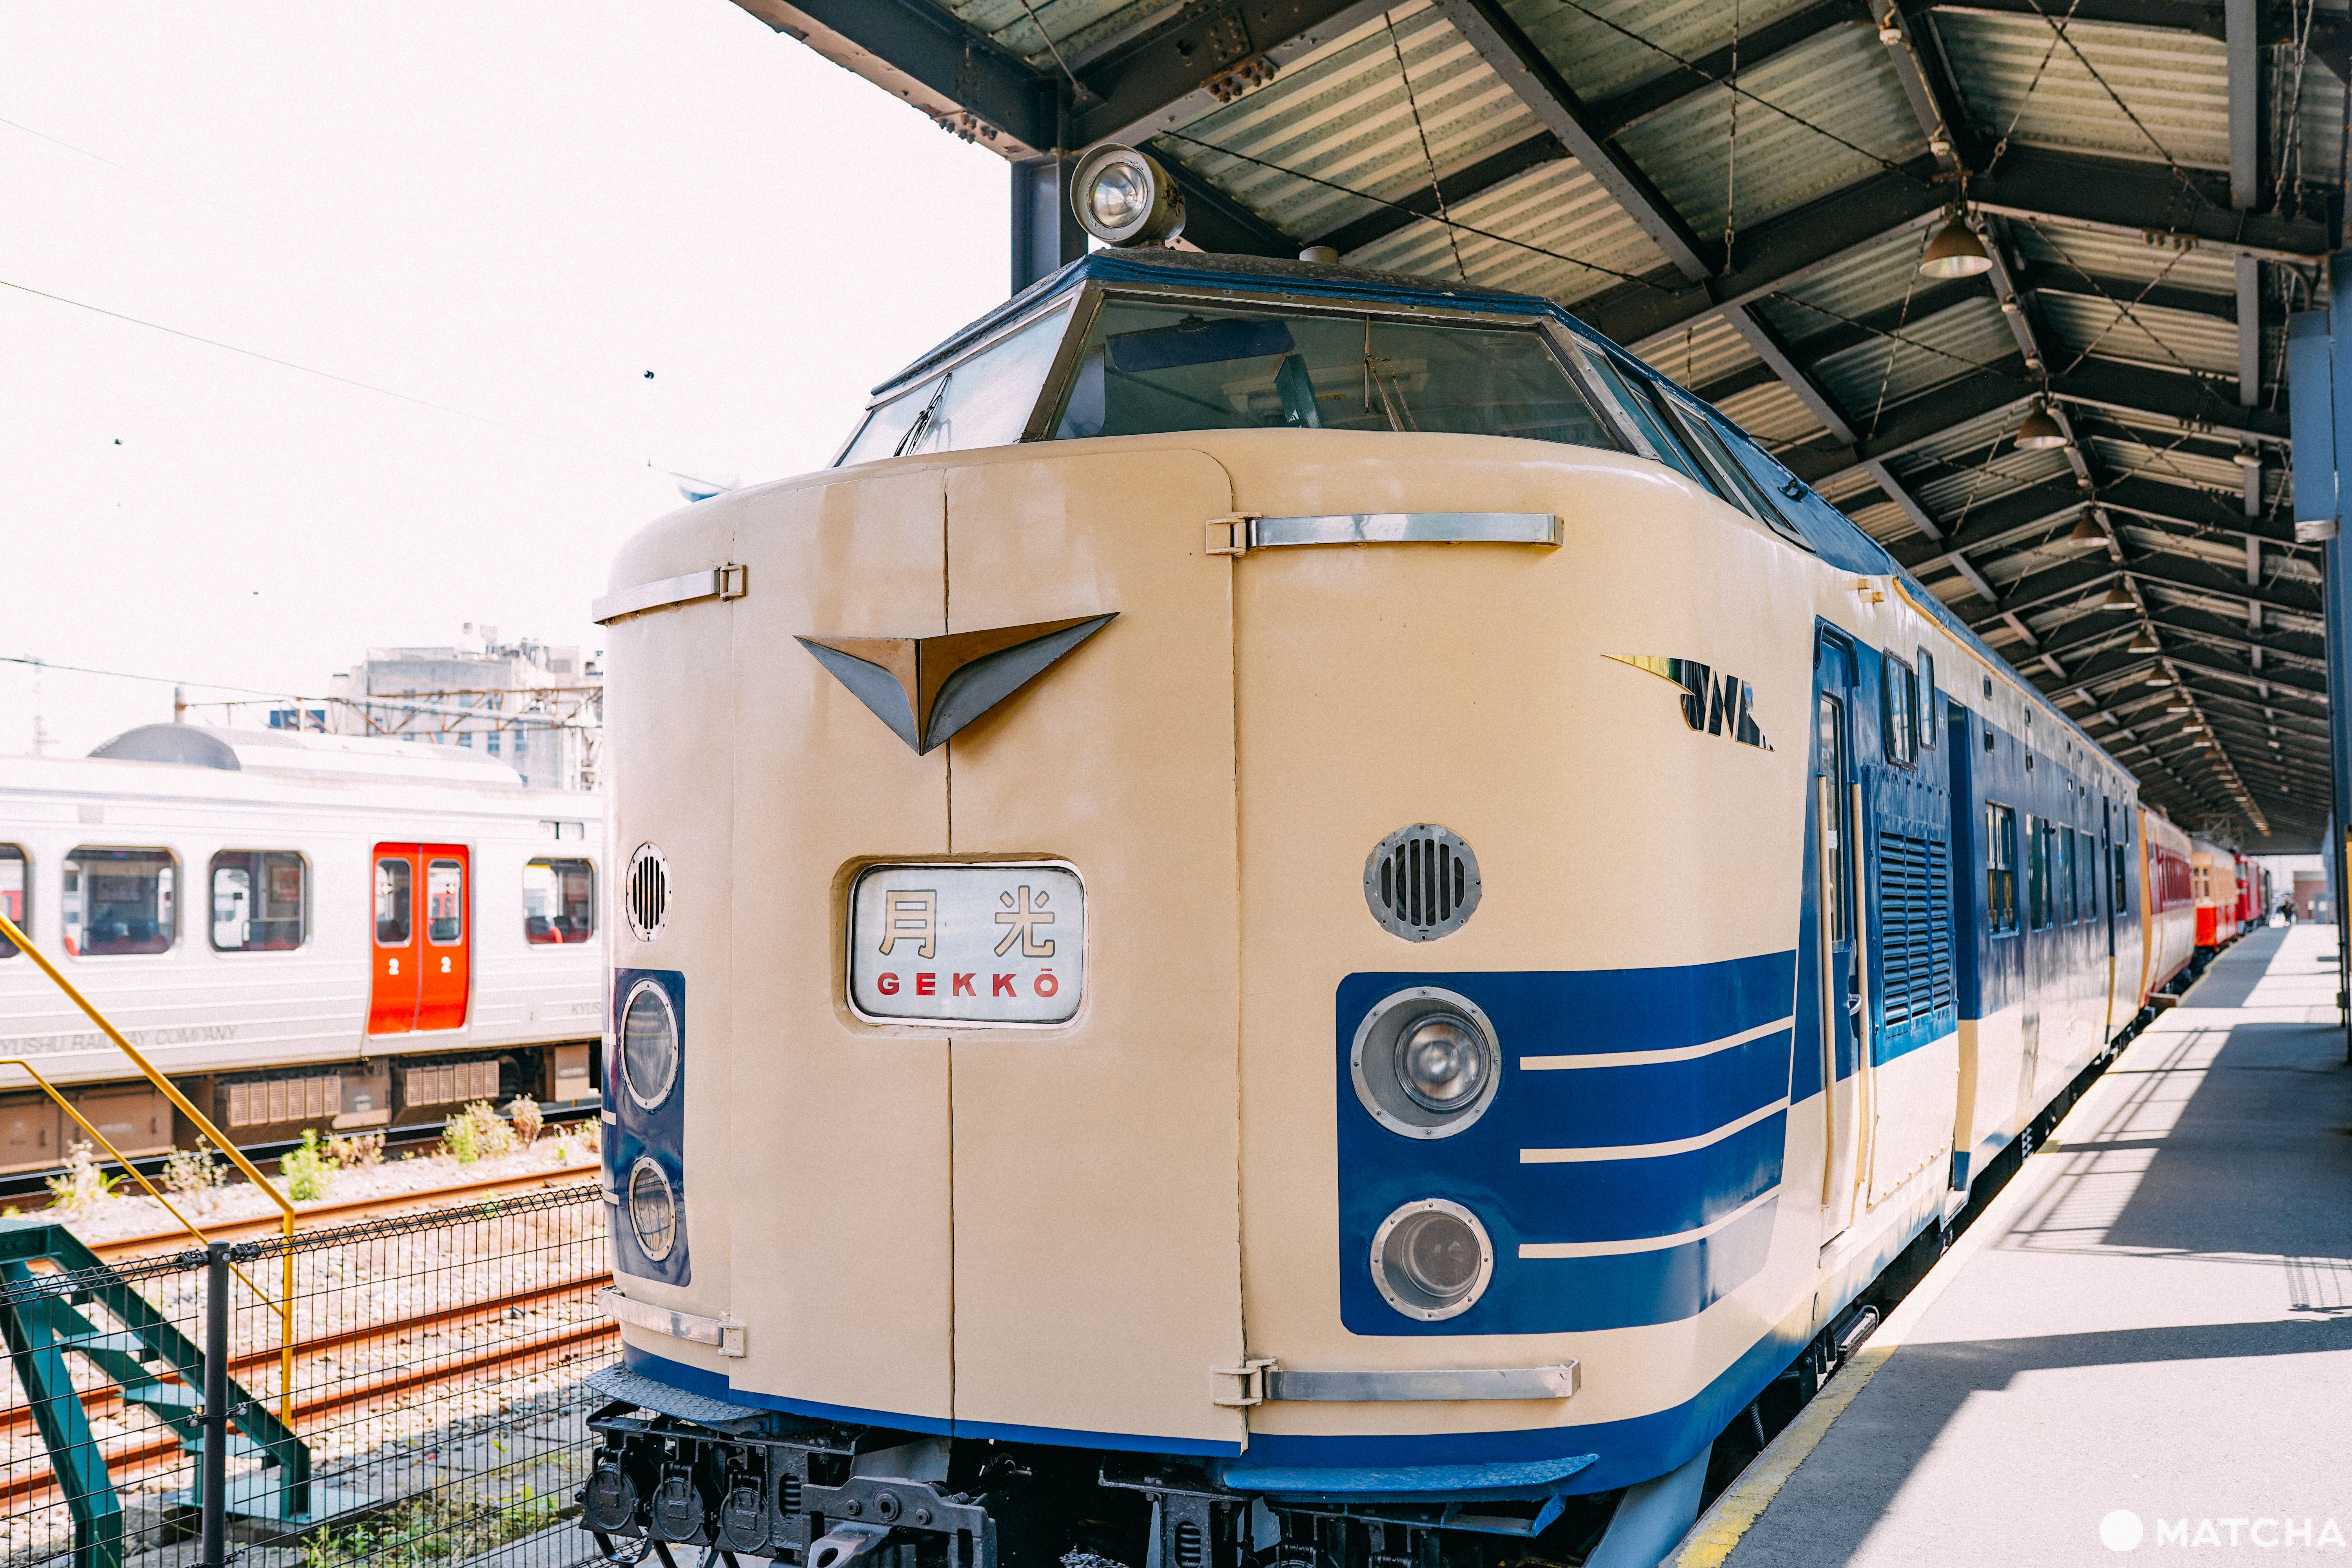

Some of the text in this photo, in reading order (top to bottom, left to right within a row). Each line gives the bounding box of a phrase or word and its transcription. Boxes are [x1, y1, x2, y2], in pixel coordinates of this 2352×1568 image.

[879, 885, 1055, 959] 月光
[389, 958, 399, 975] 2
[441, 956, 451, 973] 2
[877, 968, 1059, 998] GEKKŌ
[71, 1031, 149, 1050] RAILAY
